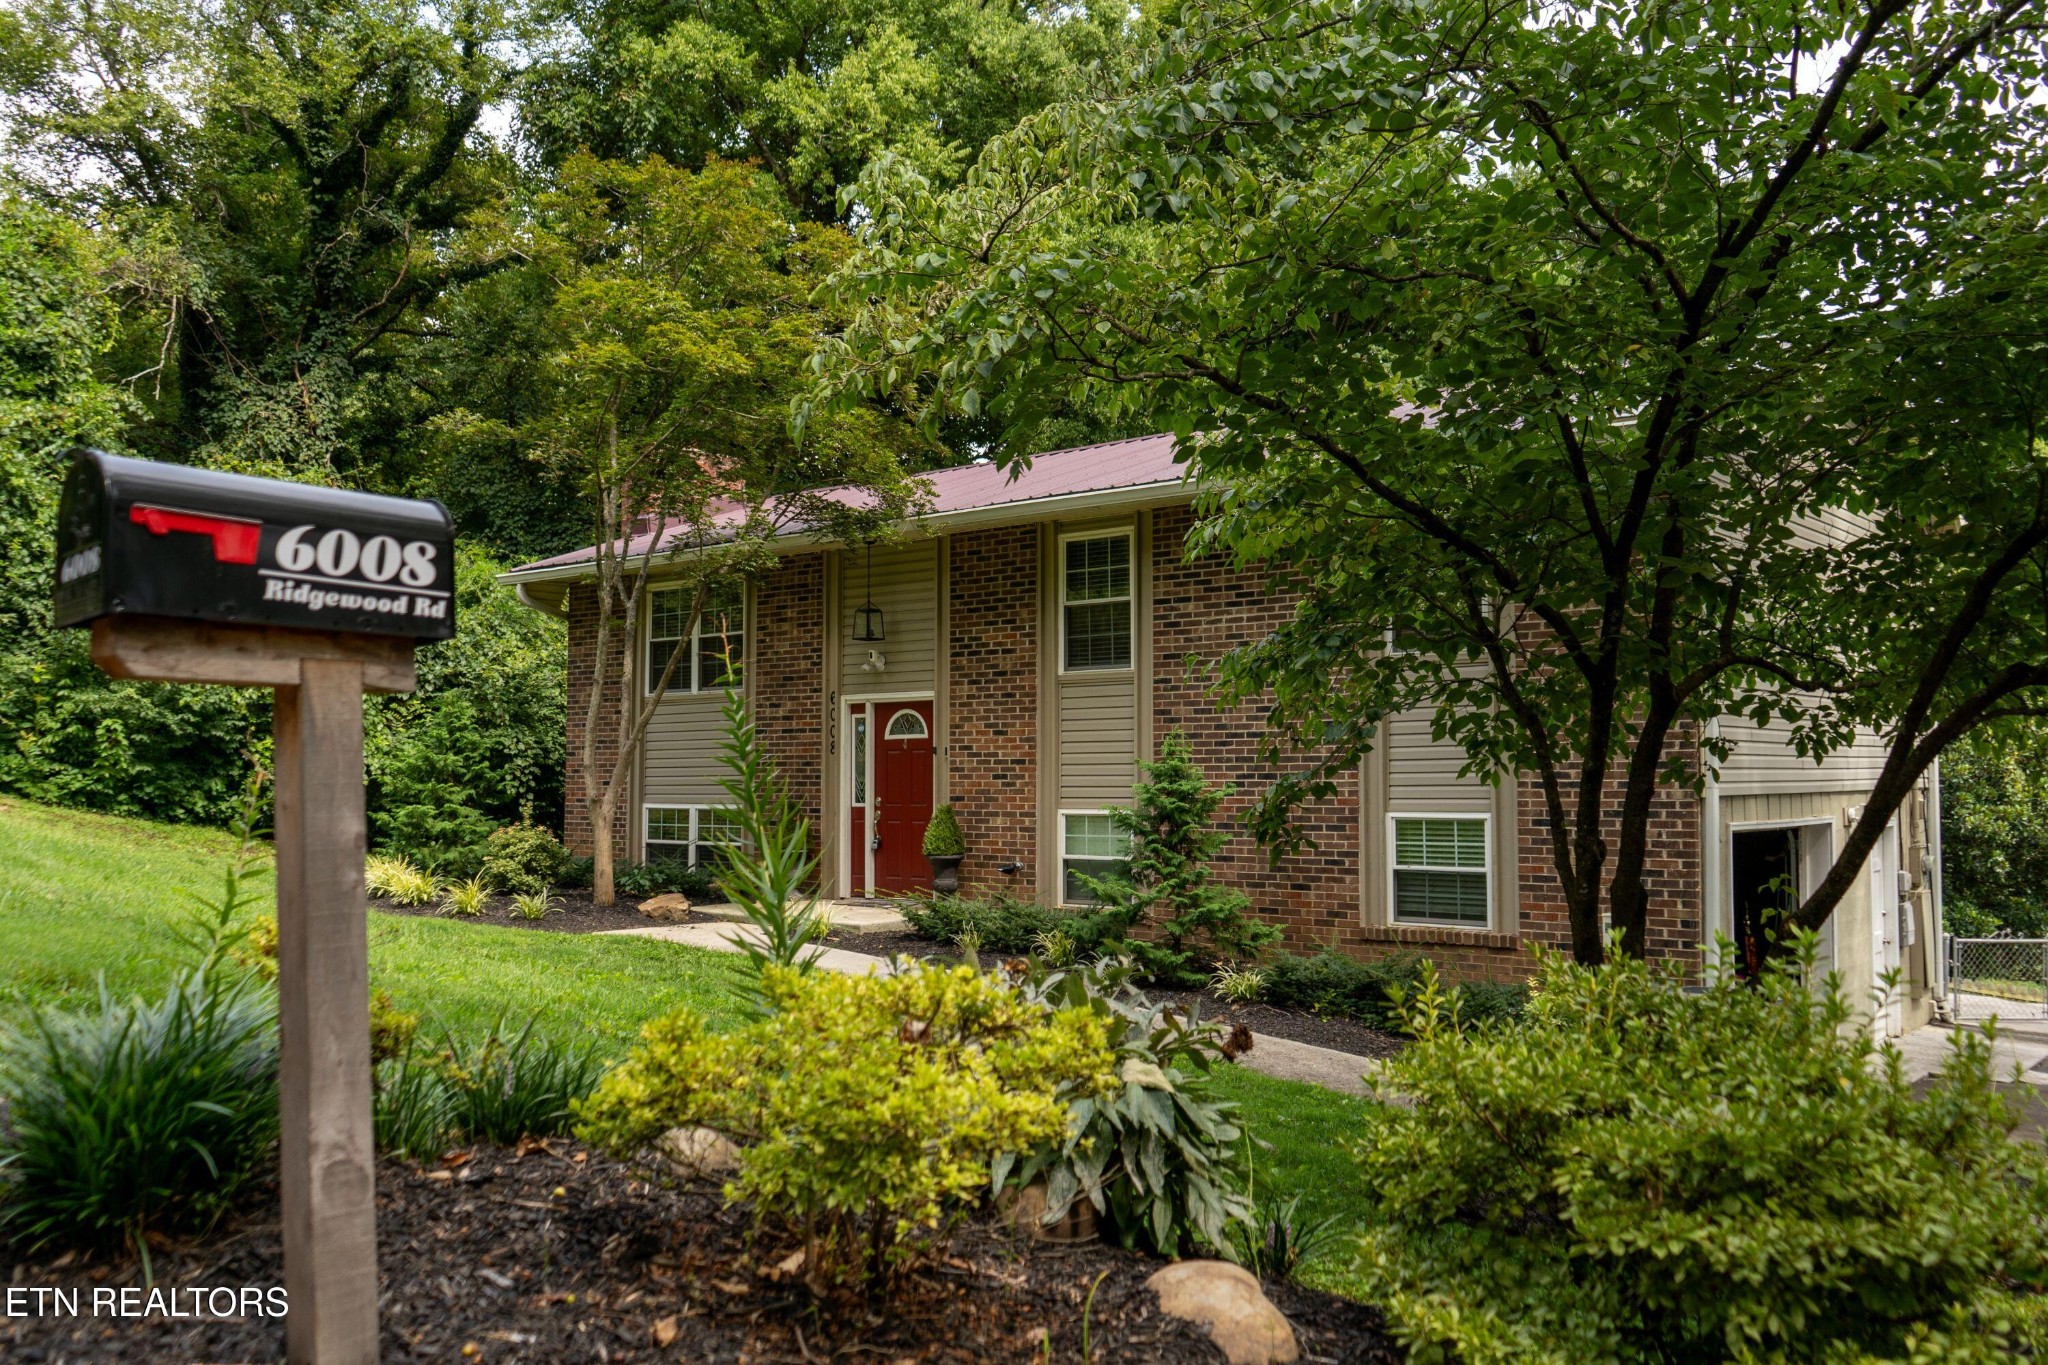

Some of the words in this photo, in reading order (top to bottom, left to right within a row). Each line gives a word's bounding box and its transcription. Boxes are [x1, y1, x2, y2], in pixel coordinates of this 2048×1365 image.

[275, 524, 437, 587] 6008
[263, 578, 409, 615] Ridgewood
[412, 597, 448, 619] Rd
